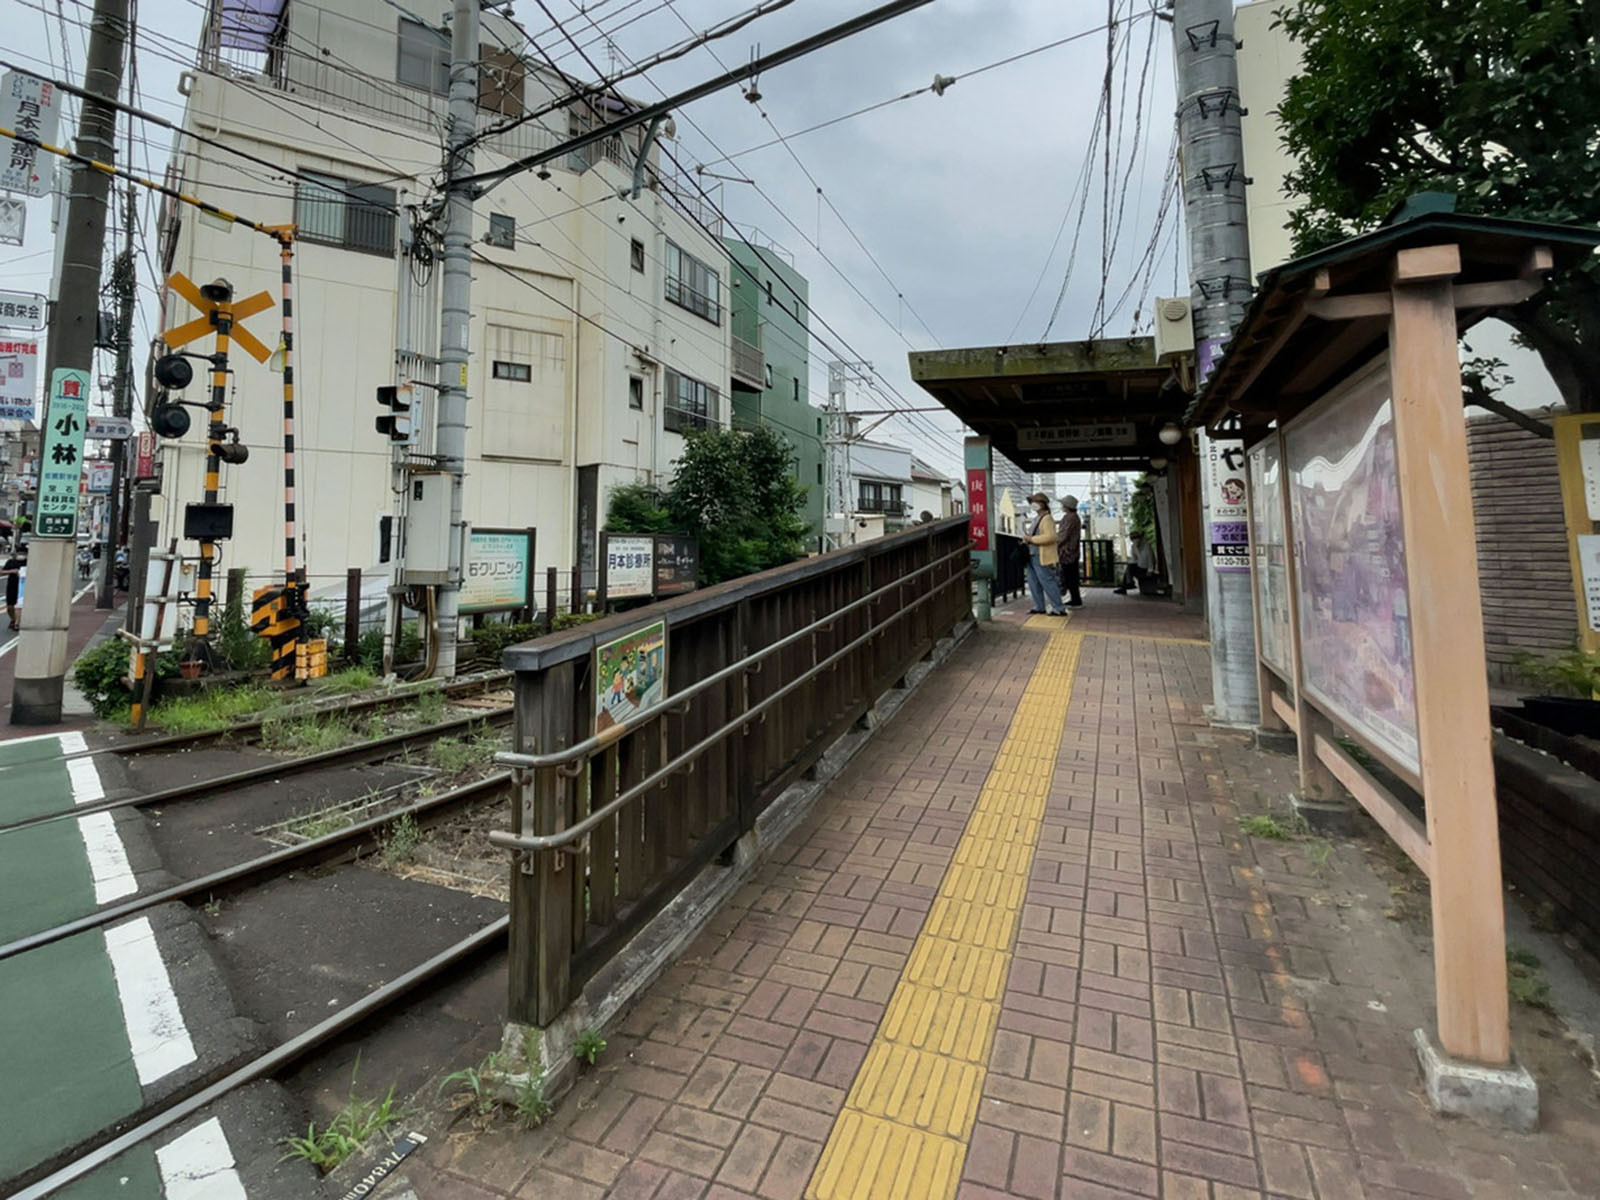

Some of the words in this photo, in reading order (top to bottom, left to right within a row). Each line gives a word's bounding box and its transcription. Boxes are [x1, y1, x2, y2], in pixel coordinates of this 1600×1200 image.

[51, 412, 80, 466] 小林
[971, 479, 986, 538] 庚申塚
[608, 553, 651, 570] 月本診療所
